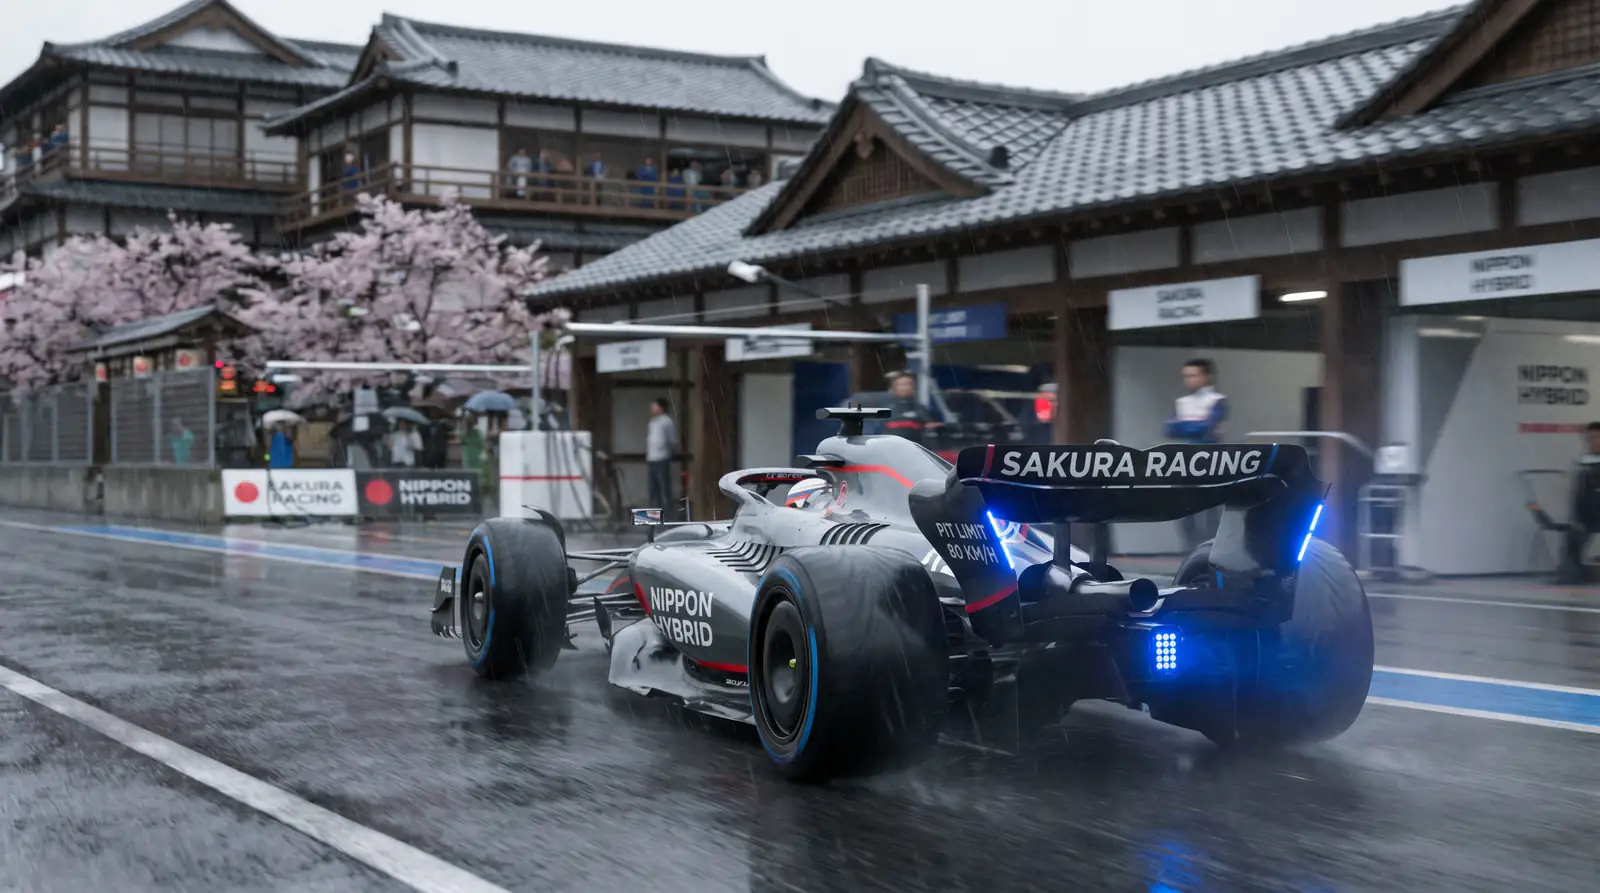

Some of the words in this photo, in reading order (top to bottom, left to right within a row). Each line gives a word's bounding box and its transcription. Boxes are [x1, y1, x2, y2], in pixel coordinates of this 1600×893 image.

[1470, 254, 1534, 272] NIPPON
[1470, 274, 1534, 293] HYBRID
[1518, 365, 1588, 383] NIPPON
[1518, 386, 1589, 405] HYBRID
[1000, 451, 1136, 479] SAKURA
[1145, 450, 1262, 478] RACING
[399, 479, 472, 492] NIPPON
[400, 491, 472, 505] HYBRID
[936, 522, 956, 538] PIT
[954, 523, 987, 540] LIMIT
[947, 543, 964, 560] 80
[963, 543, 999, 565] KM/H
[650, 586, 714, 618] NIPPON
[653, 614, 713, 647] HYBRID
